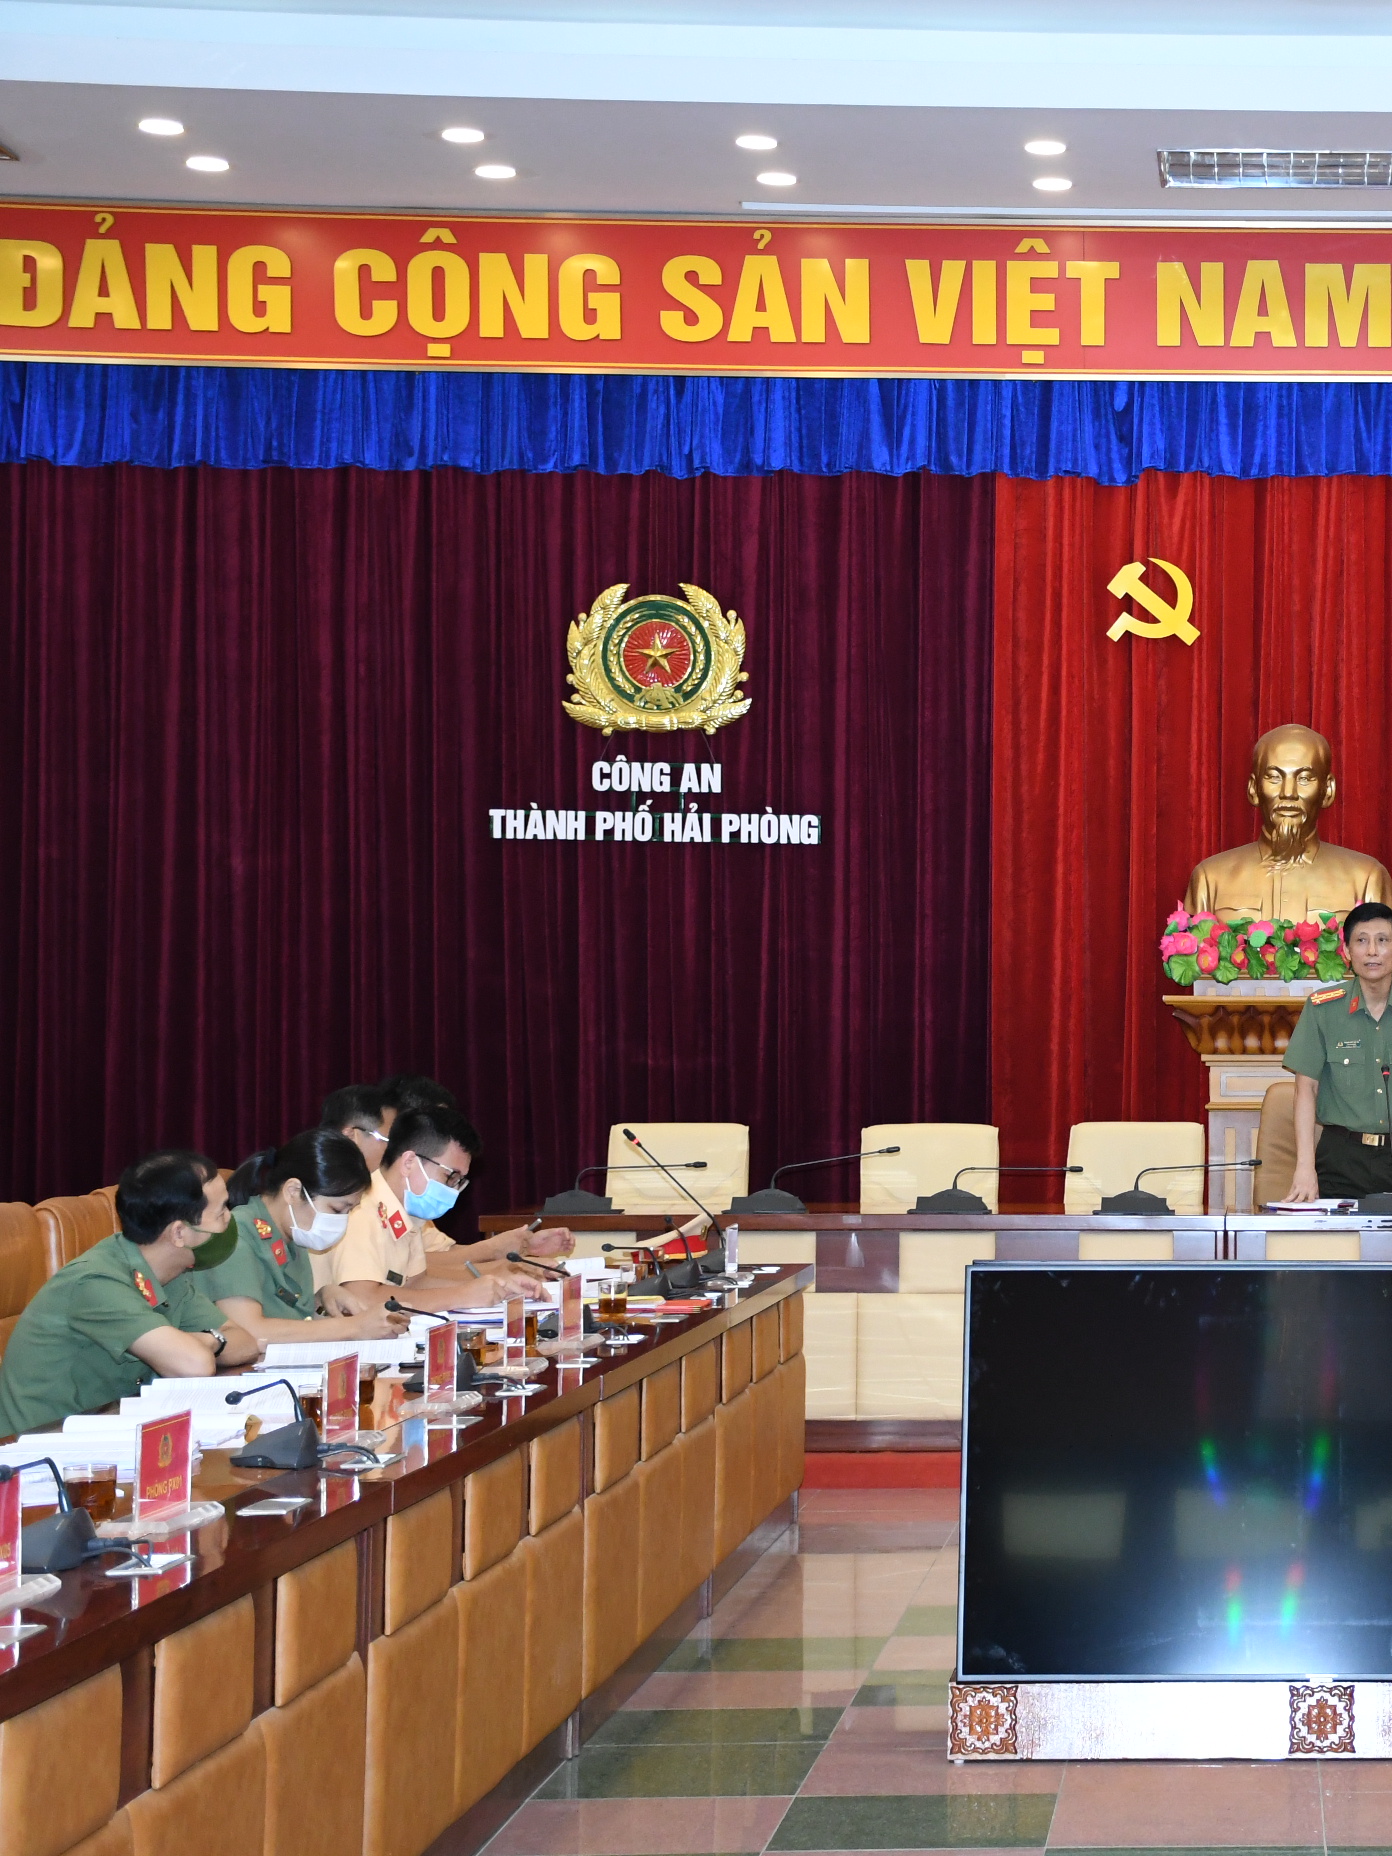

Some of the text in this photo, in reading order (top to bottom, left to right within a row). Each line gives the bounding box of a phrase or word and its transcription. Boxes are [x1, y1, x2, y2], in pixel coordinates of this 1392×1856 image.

[0, 214, 293, 333] ĐẢNG
[333, 228, 622, 357] CỘNG
[660, 228, 871, 343] SẢN
[906, 238, 1120, 364] VIỆT
[1157, 260, 1392, 348] NAM
[591, 755, 722, 793] CÔNG AN
[488, 799, 819, 845] THÀNH PHỐ HẢI PHÒNG
